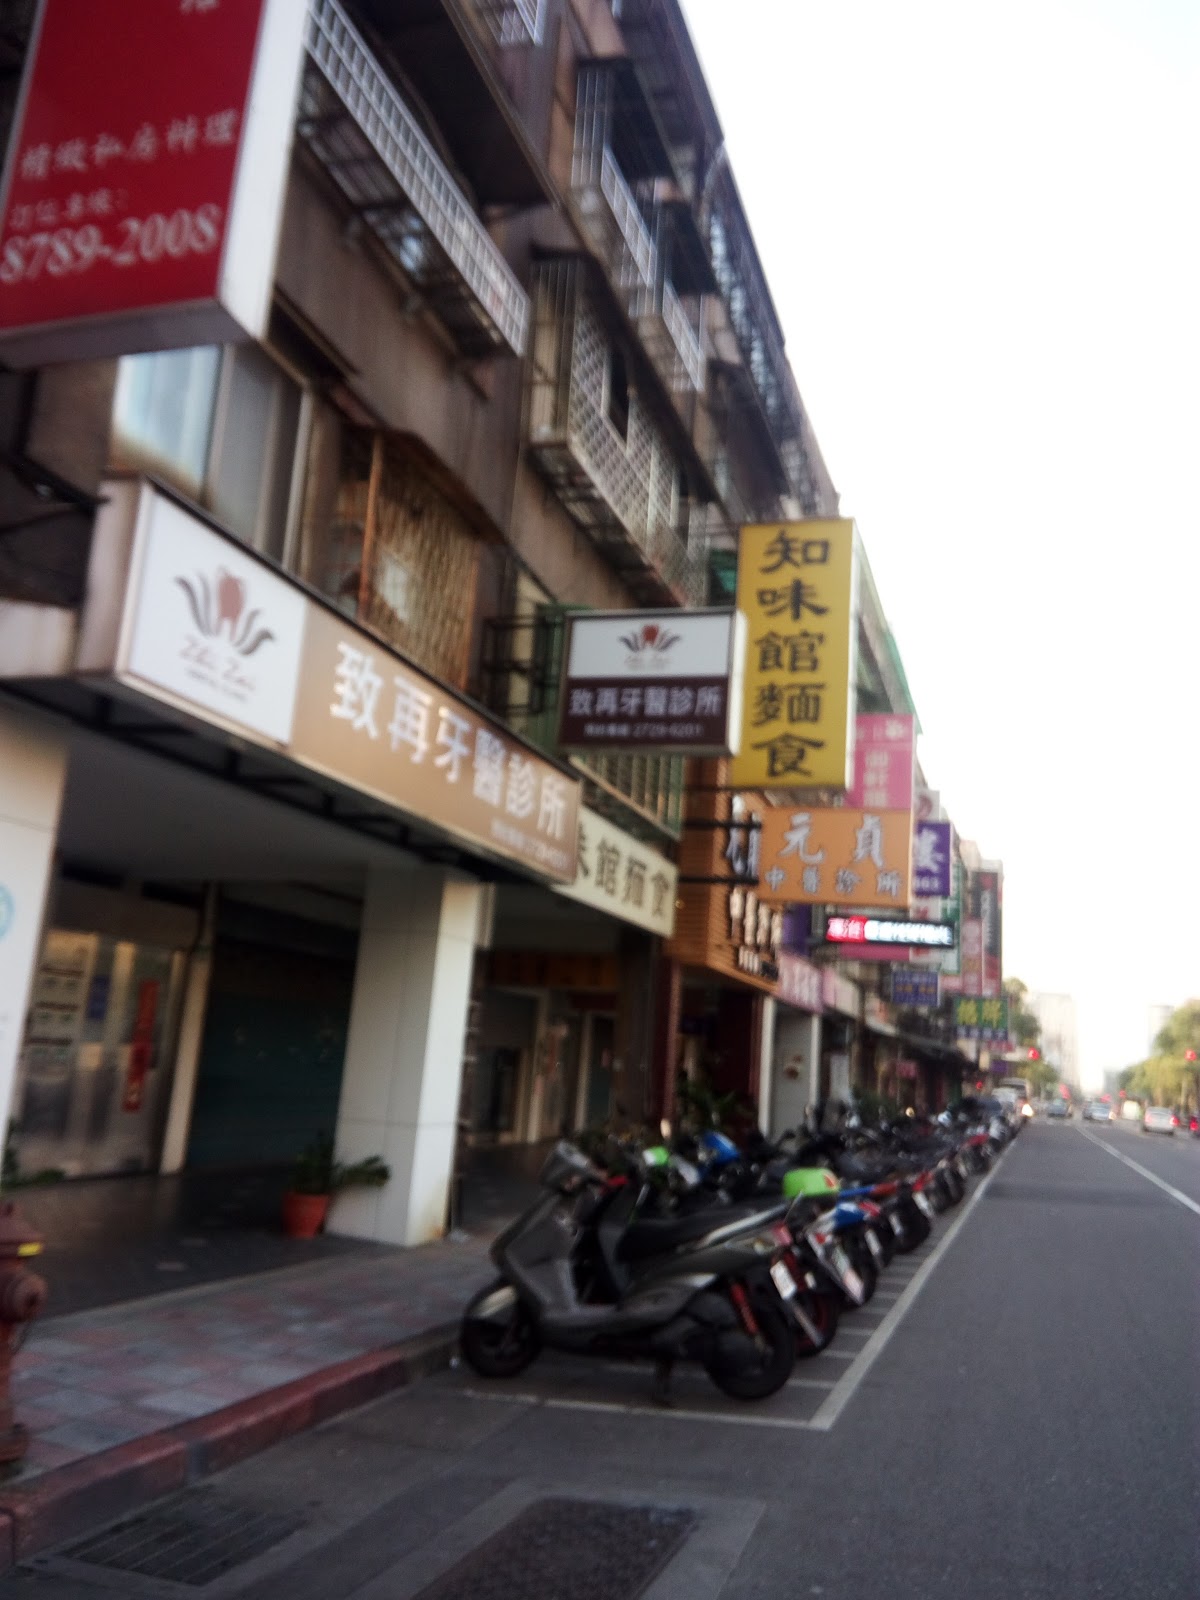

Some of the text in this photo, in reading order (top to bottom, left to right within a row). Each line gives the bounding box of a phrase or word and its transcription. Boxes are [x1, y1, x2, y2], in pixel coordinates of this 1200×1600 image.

[0, 202, 222, 284] 8789-2008
[752, 528, 831, 779] 知味館麵食
[329, 640, 568, 842] 致再牙醫診所
[568, 685, 723, 718] 致再牙醫診所
[778, 812, 887, 869] 元貞
